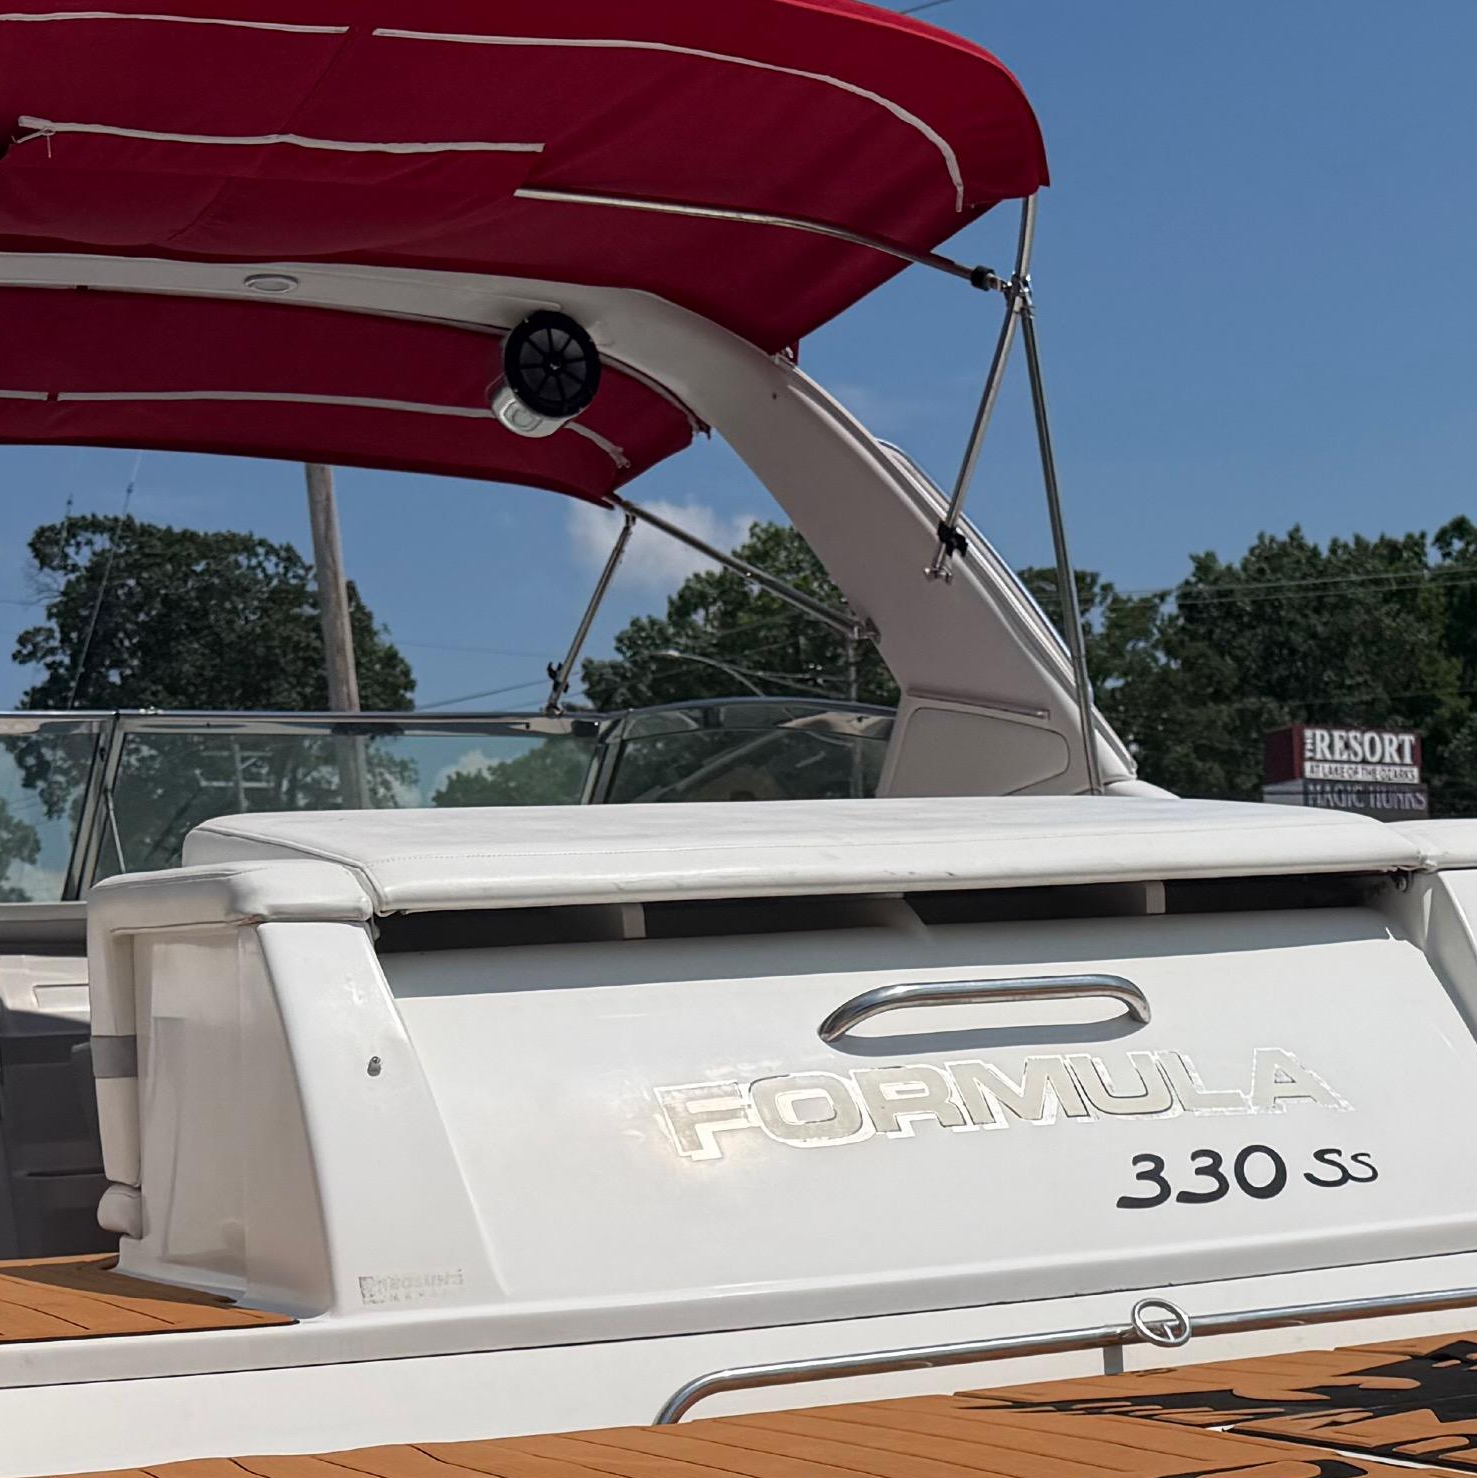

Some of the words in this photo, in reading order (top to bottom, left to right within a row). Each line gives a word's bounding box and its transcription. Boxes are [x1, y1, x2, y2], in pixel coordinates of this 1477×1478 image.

[1315, 729, 1415, 764] RESORT
[654, 1047, 1354, 1162] FORMULA
[1116, 1144, 1287, 1209] 330
